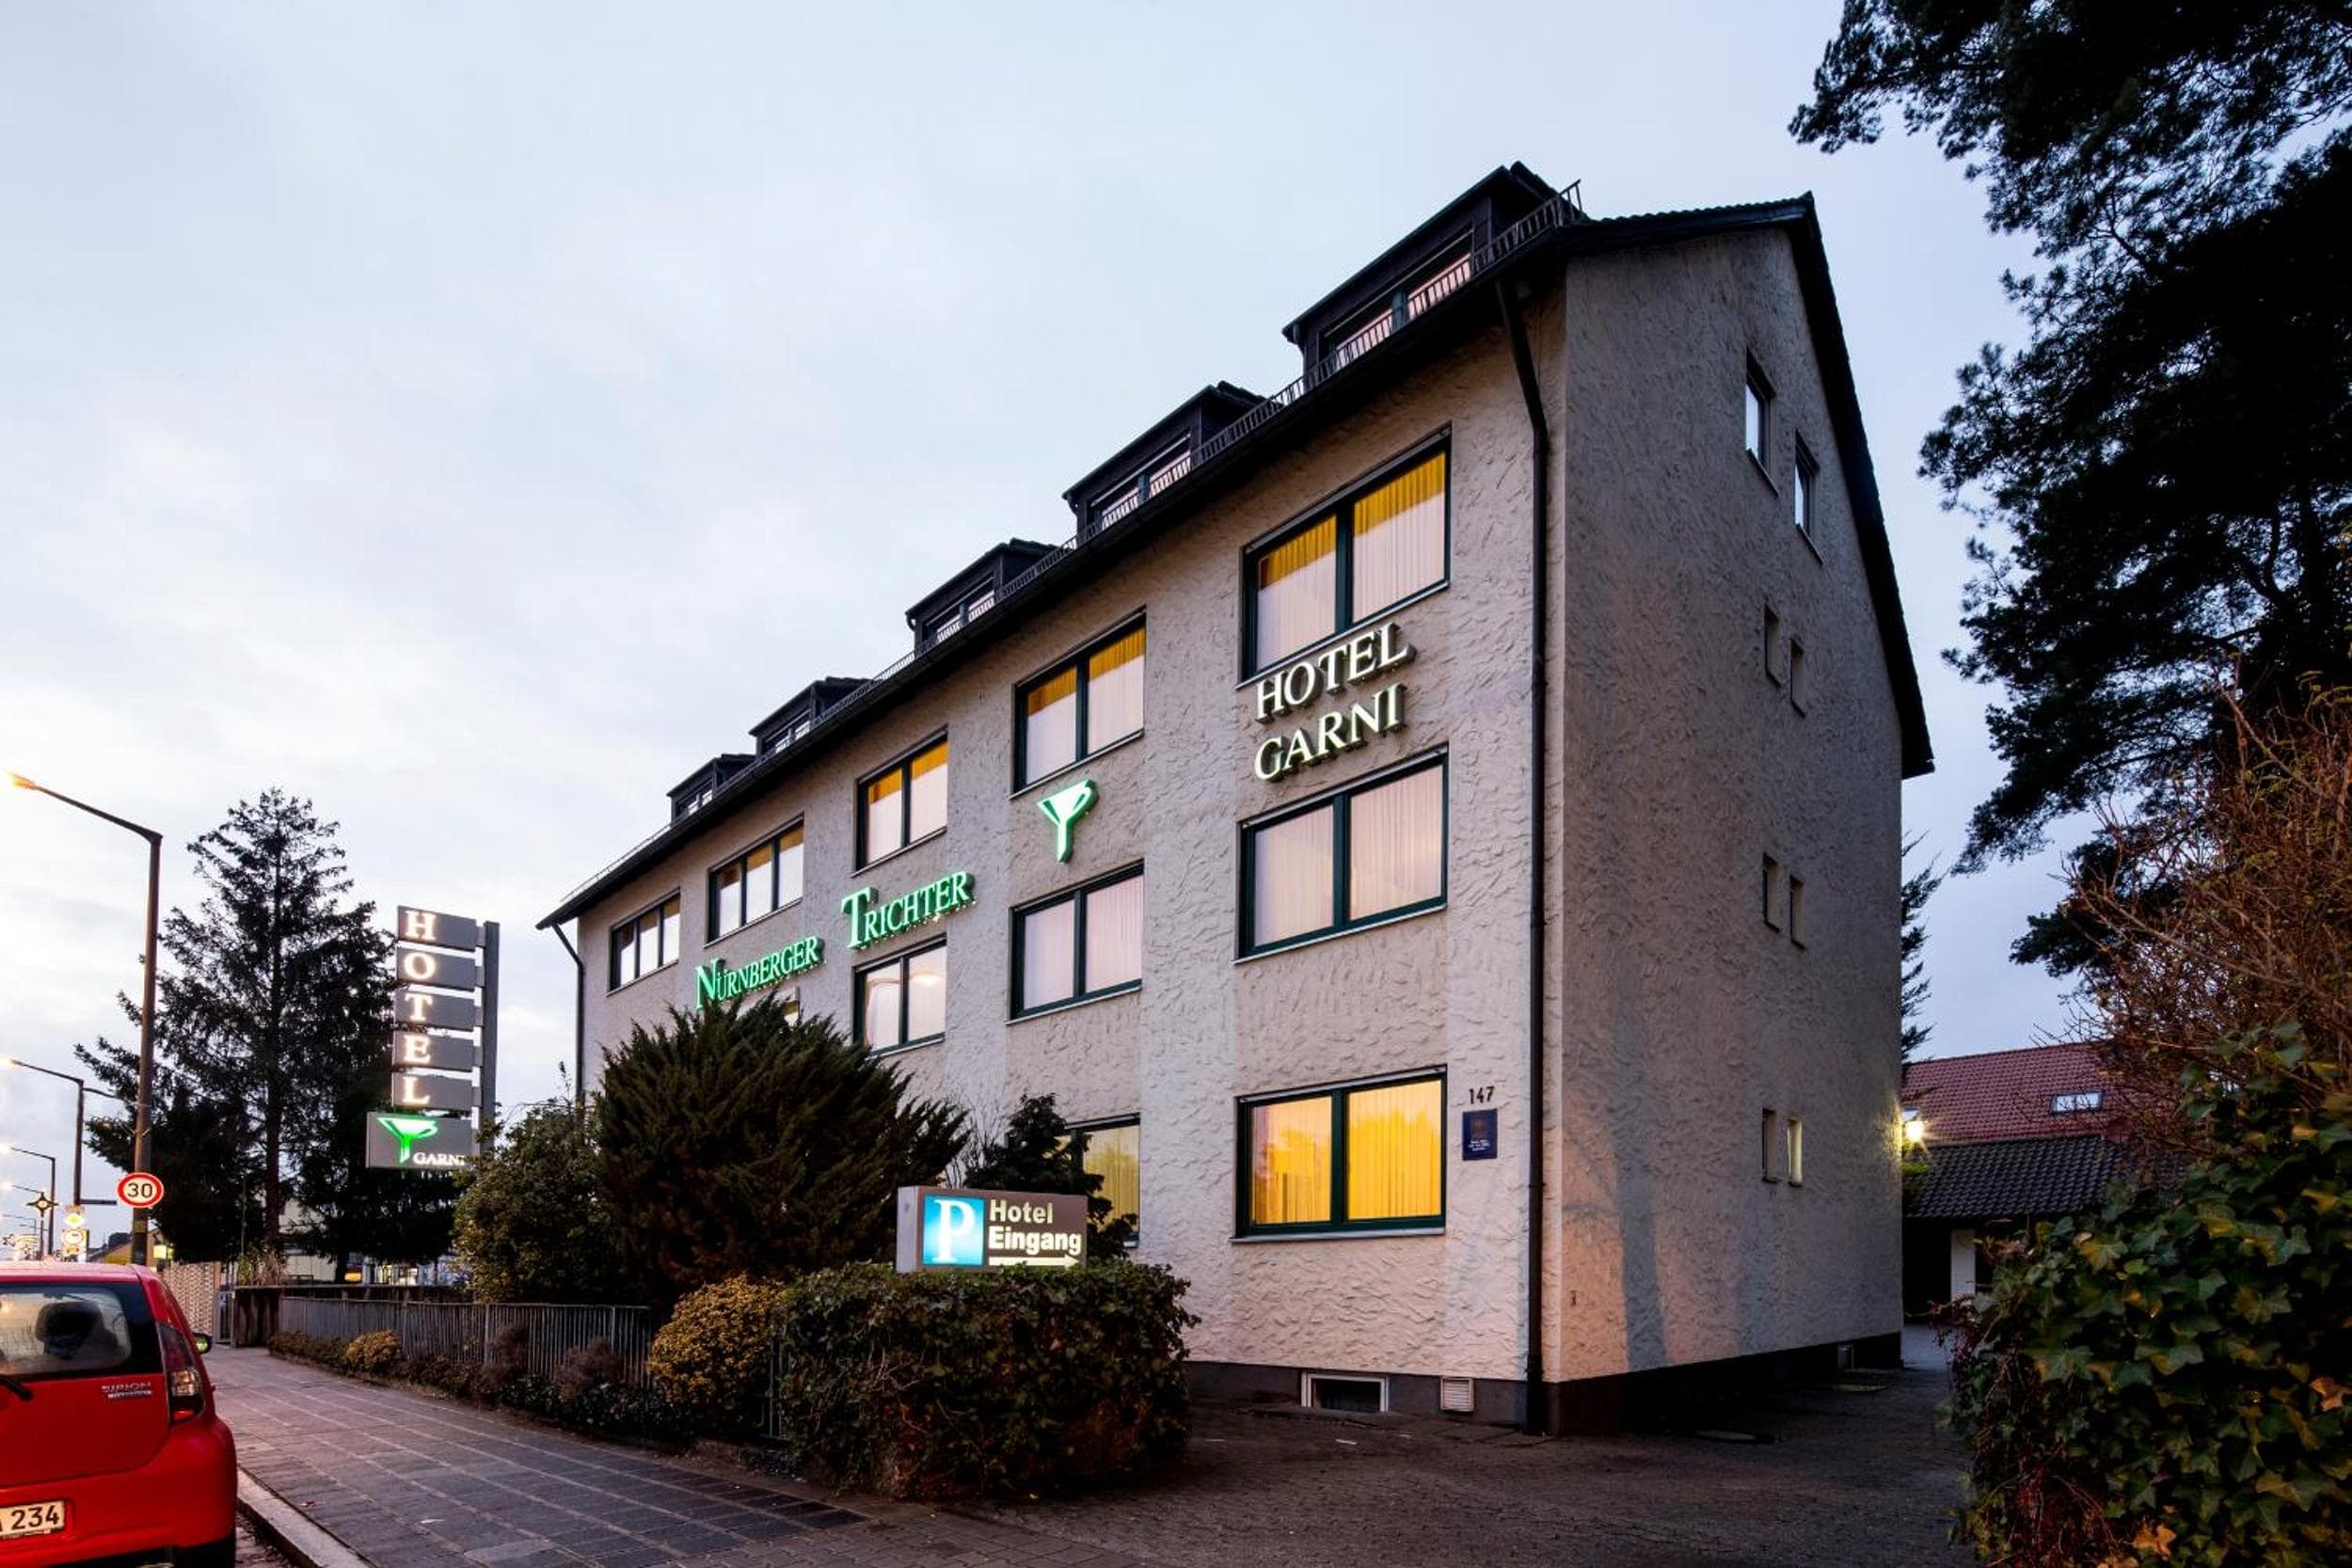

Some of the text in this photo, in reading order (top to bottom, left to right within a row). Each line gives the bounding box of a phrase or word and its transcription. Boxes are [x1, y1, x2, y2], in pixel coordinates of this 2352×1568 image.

[1255, 622, 1414, 722] HOTEL
[1254, 683, 1406, 781] GARNI
[403, 910, 437, 1110] HOTEL
[1469, 1085, 1496, 1105] 147
[127, 1181, 153, 1198] 30
[989, 1199, 1054, 1224] Hotel
[931, 1198, 976, 1263] P
[989, 1226, 1082, 1256] Eingang
[10, 1505, 60, 1530] 234
